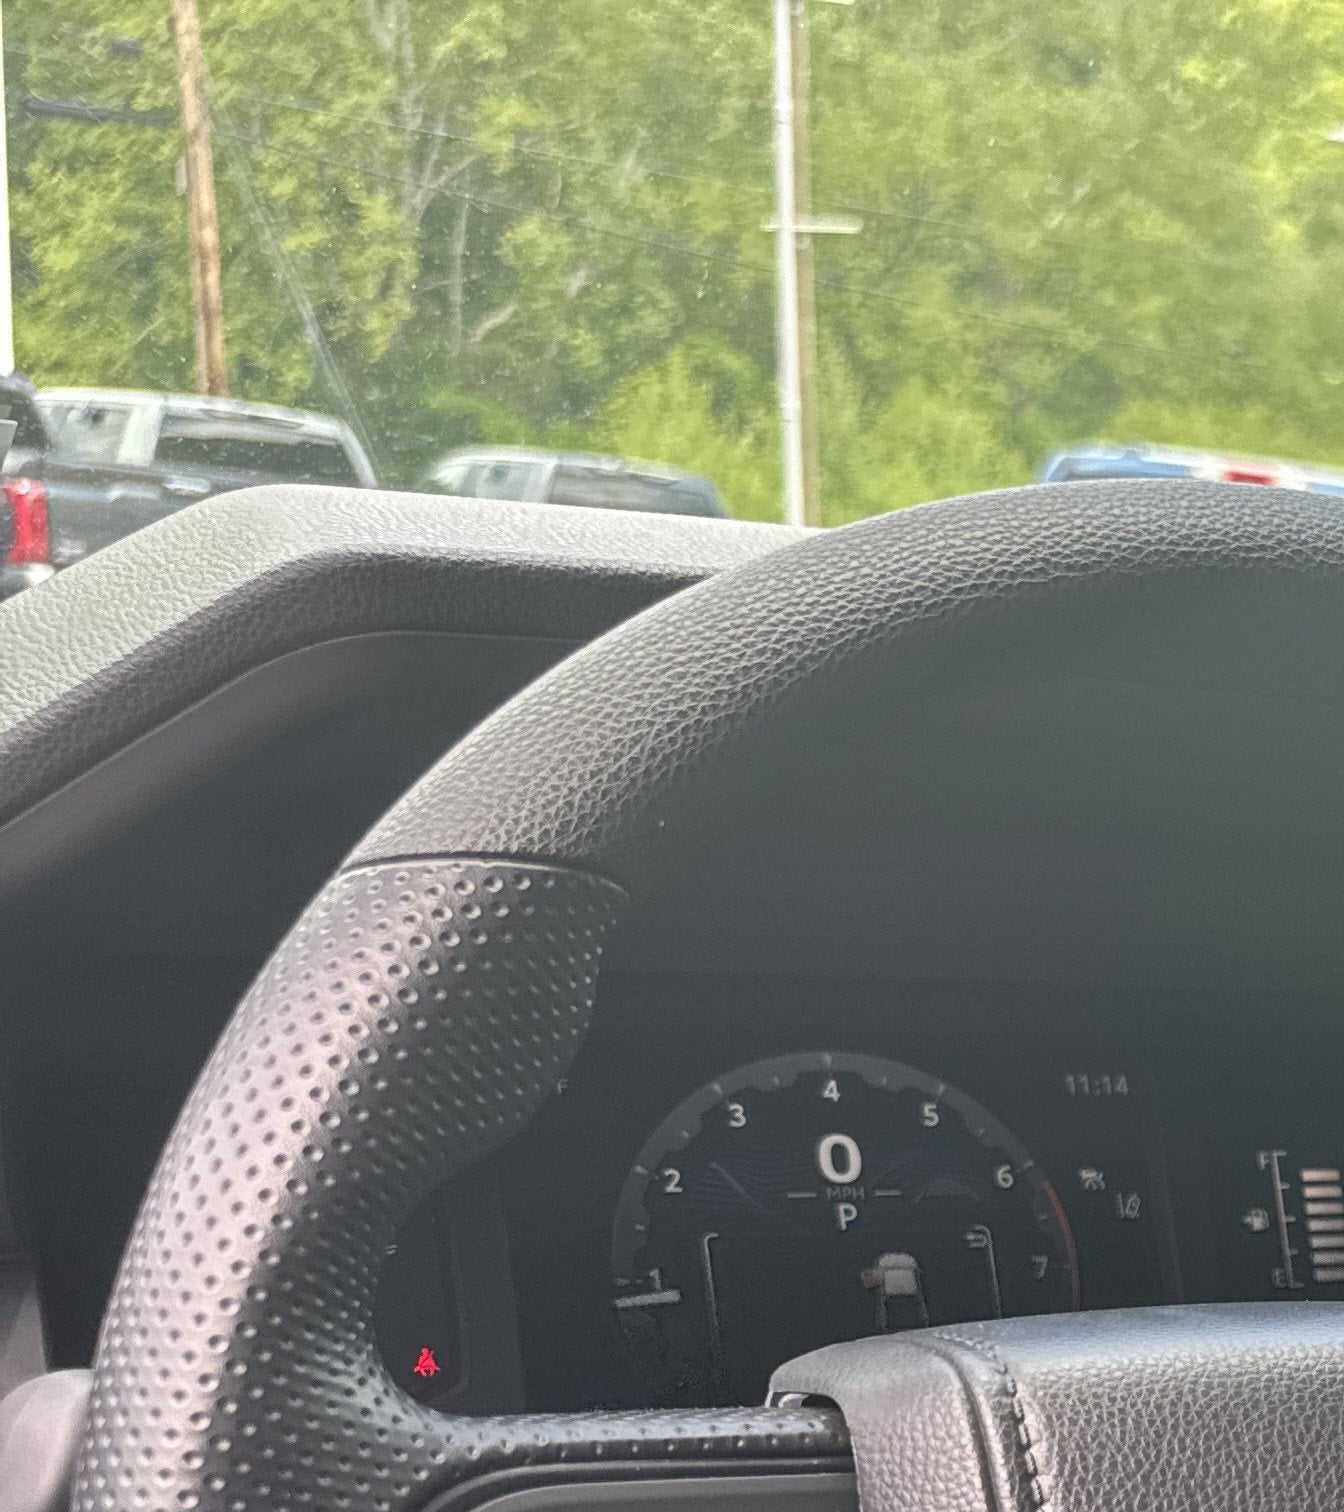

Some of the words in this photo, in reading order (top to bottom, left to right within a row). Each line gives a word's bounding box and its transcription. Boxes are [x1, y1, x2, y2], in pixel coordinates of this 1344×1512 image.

[822, 1079, 841, 1102] 4
[1064, 1074, 1129, 1097] 11:14
[728, 1102, 747, 1128] 3
[921, 1101, 940, 1127] 5
[816, 1133, 862, 1184] 0
[663, 1167, 684, 1193] 2
[994, 1163, 1015, 1189] 6
[823, 1185, 866, 1201] MPH
[837, 1202, 858, 1231] P
[1030, 1253, 1048, 1280] 7
